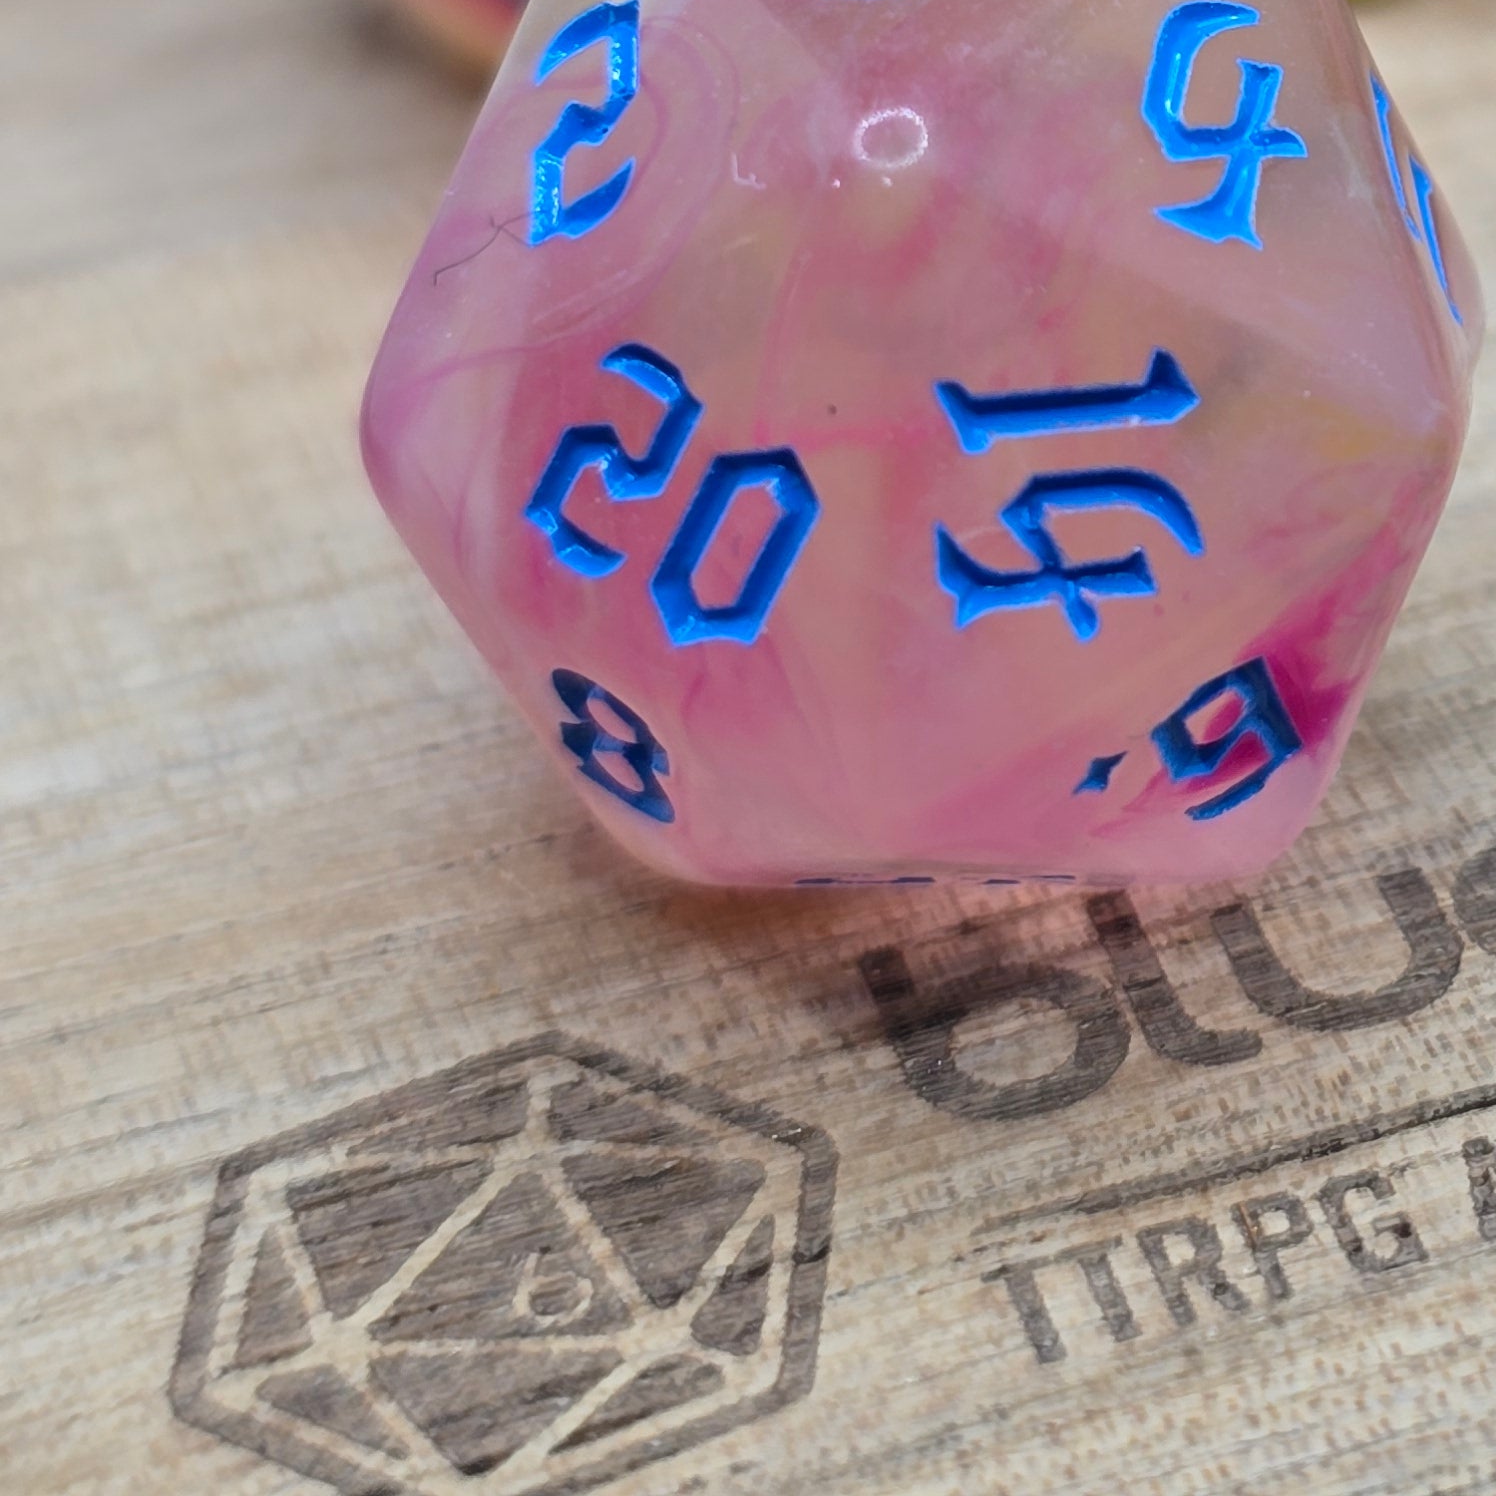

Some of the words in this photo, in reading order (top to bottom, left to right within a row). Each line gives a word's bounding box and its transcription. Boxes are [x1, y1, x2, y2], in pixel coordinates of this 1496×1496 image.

[523, 342, 822, 648] 20
[934, 348, 1204, 643] 14
[551, 666, 676, 824] 8
[981, 1168, 1430, 1365] TTRPG
